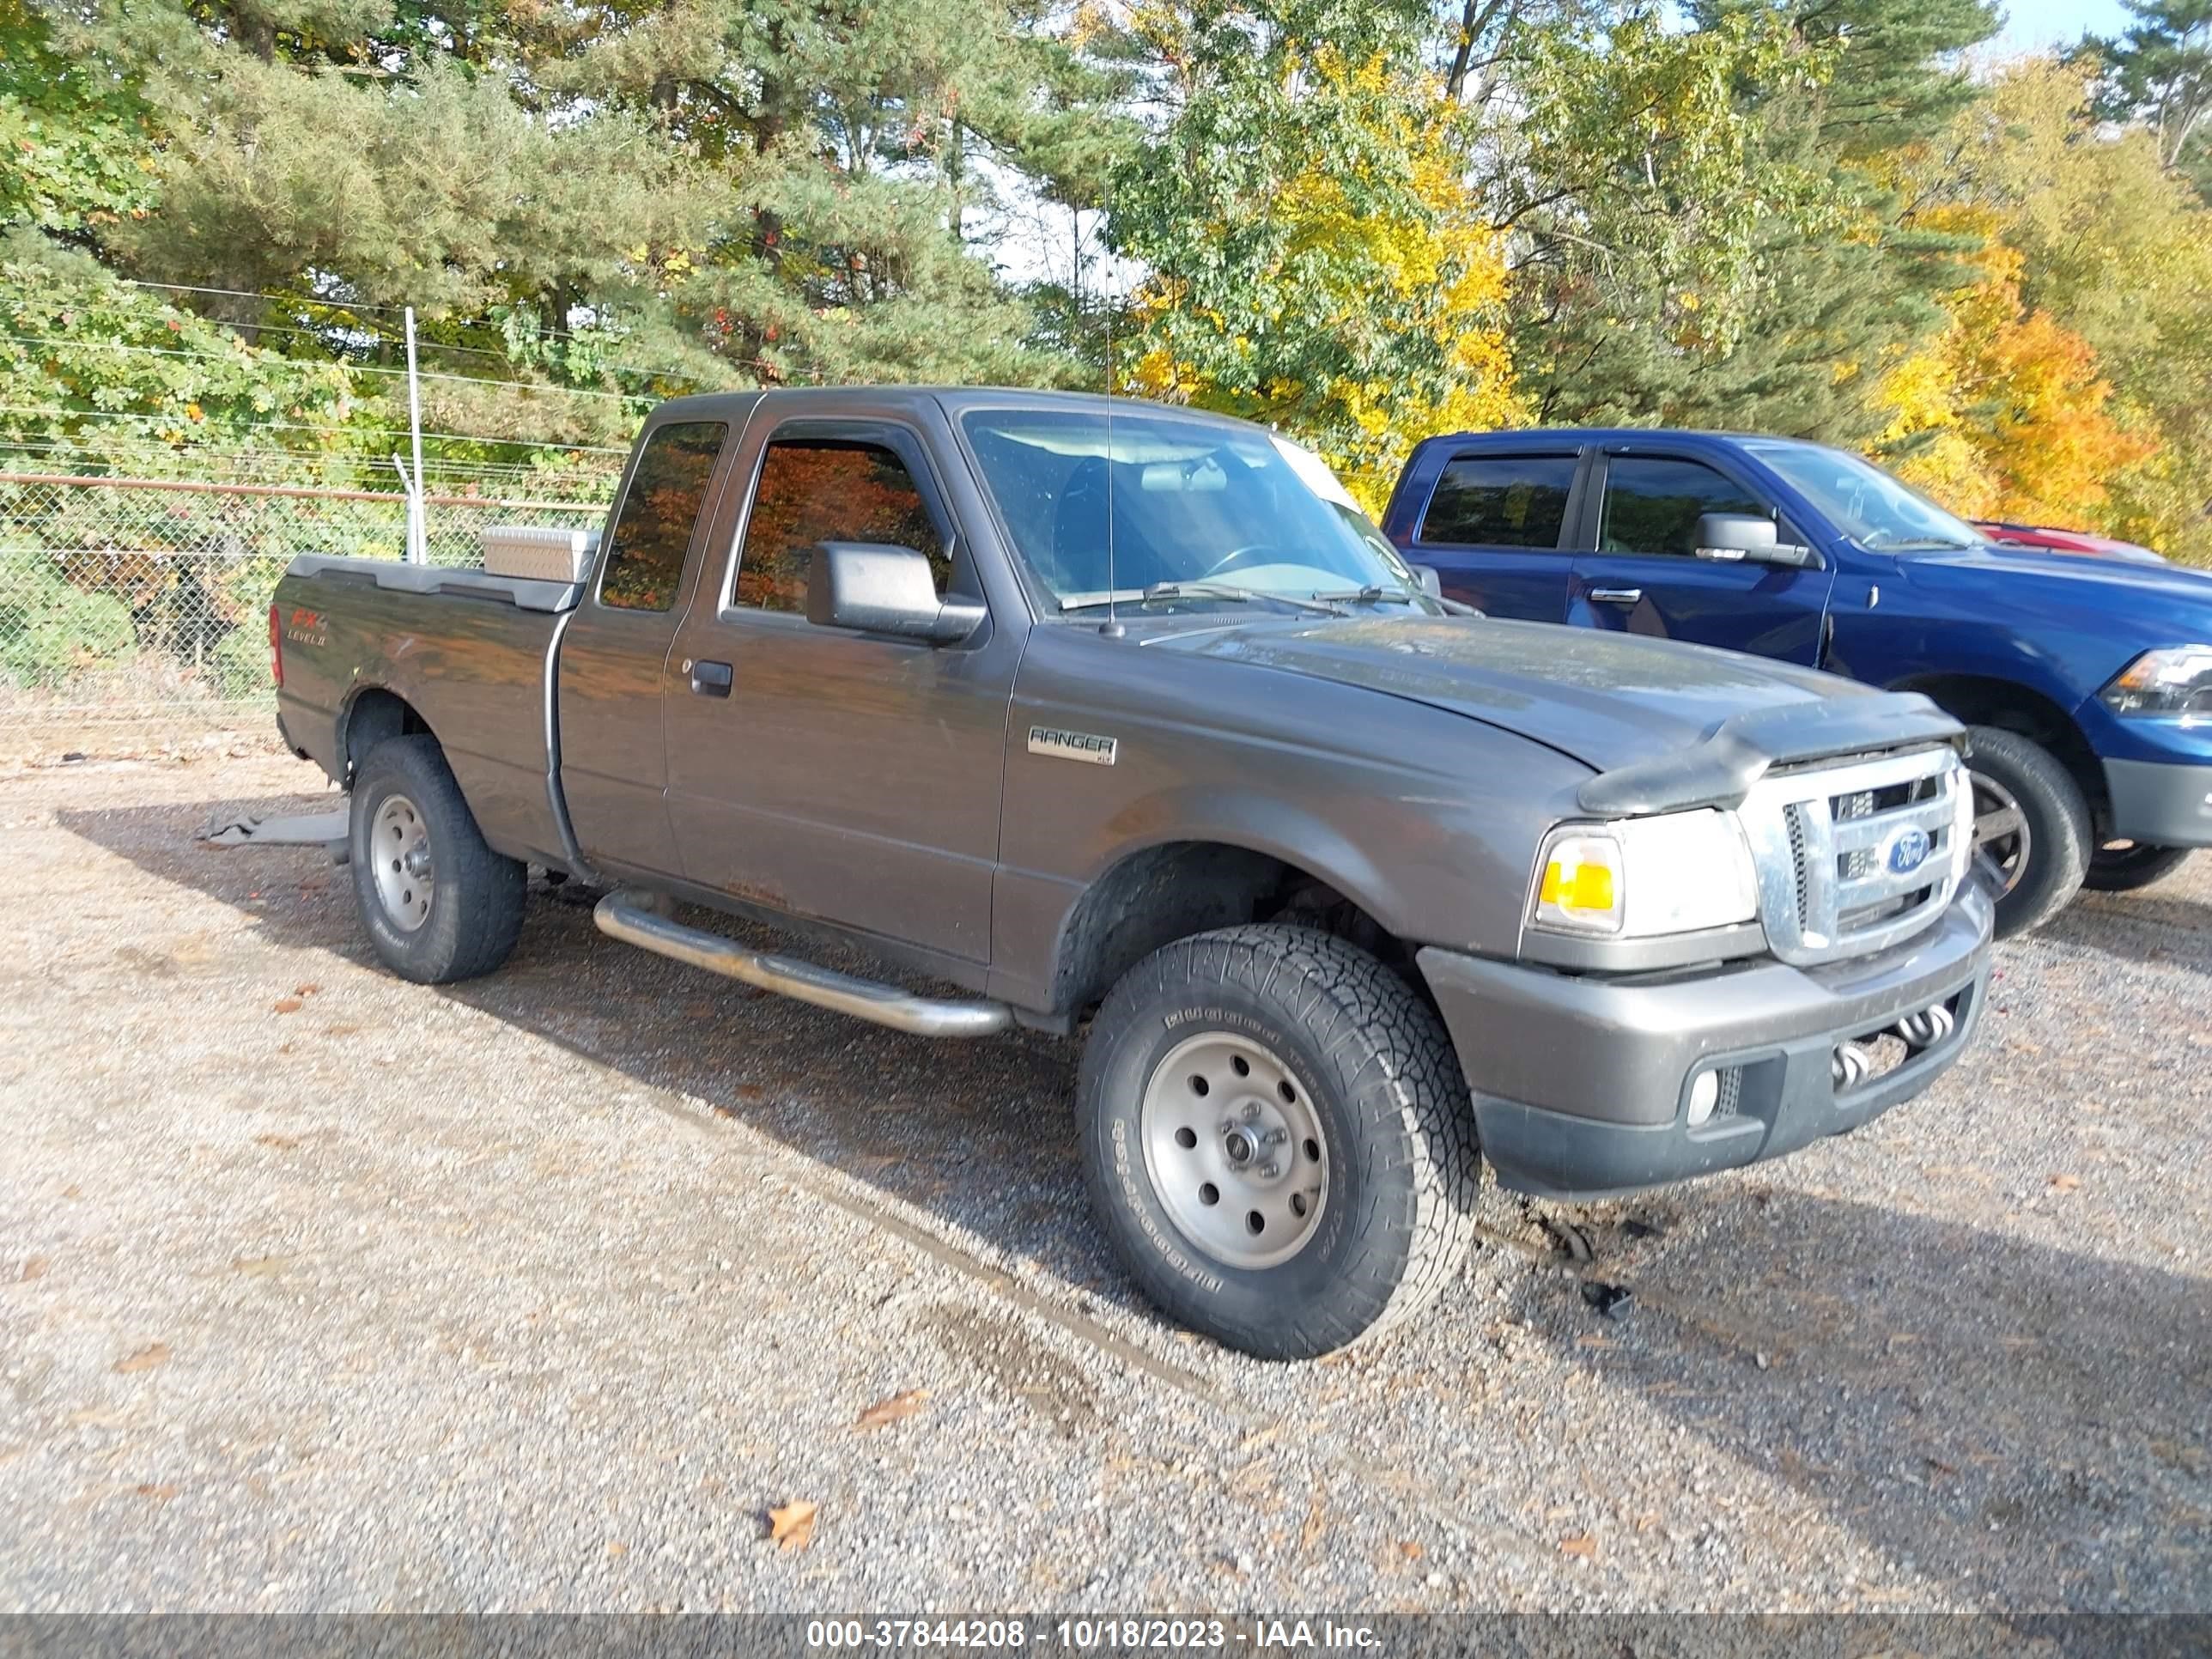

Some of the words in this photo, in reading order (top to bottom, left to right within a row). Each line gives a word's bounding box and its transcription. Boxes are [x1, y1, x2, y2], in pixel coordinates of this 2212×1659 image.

[292, 608, 328, 631] FX4
[287, 629, 315, 644] LEVEL
[1030, 729, 1113, 753] RANGER
